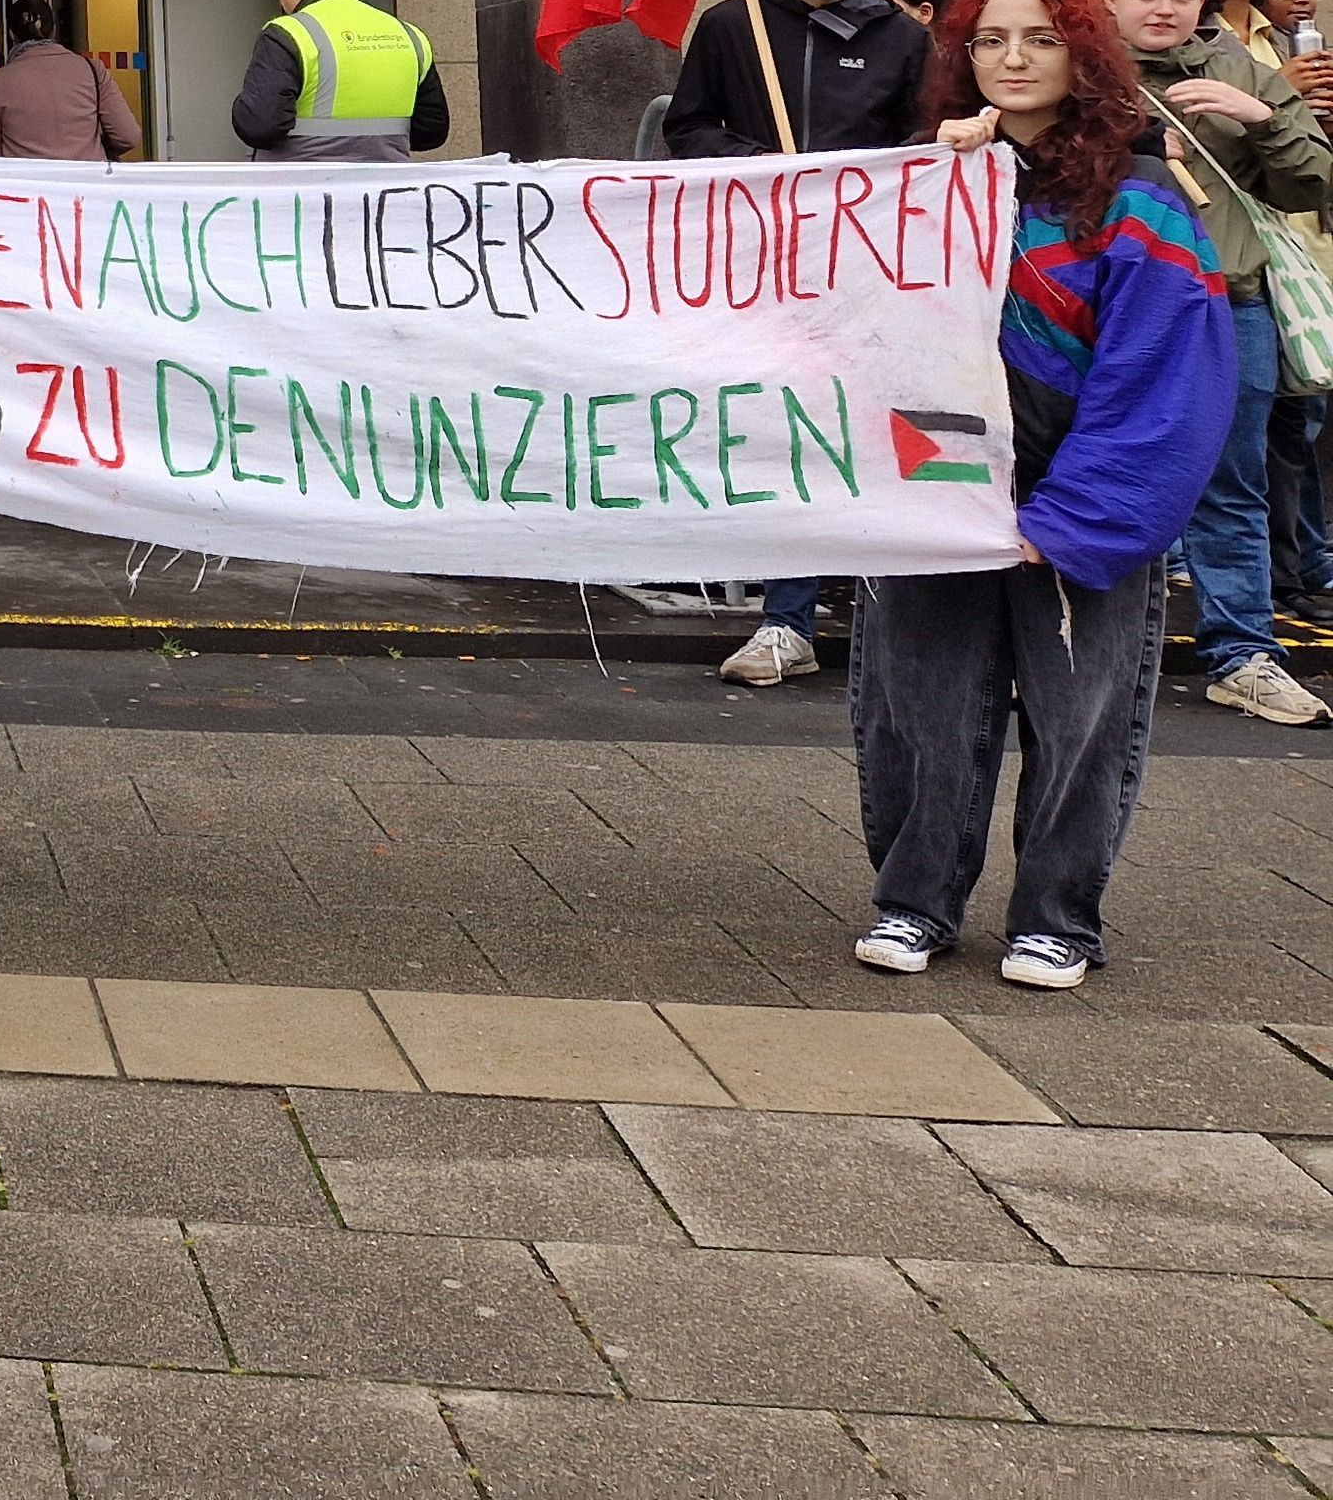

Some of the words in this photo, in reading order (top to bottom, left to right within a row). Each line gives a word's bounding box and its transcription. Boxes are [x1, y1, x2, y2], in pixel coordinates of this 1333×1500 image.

[97, 192, 307, 322] AUCH
[322, 180, 586, 320] LIEBER
[581, 150, 1000, 320] STUDIEREN
[15, 362, 126, 470] ZU
[156, 358, 861, 511] DENUNZIEREN
